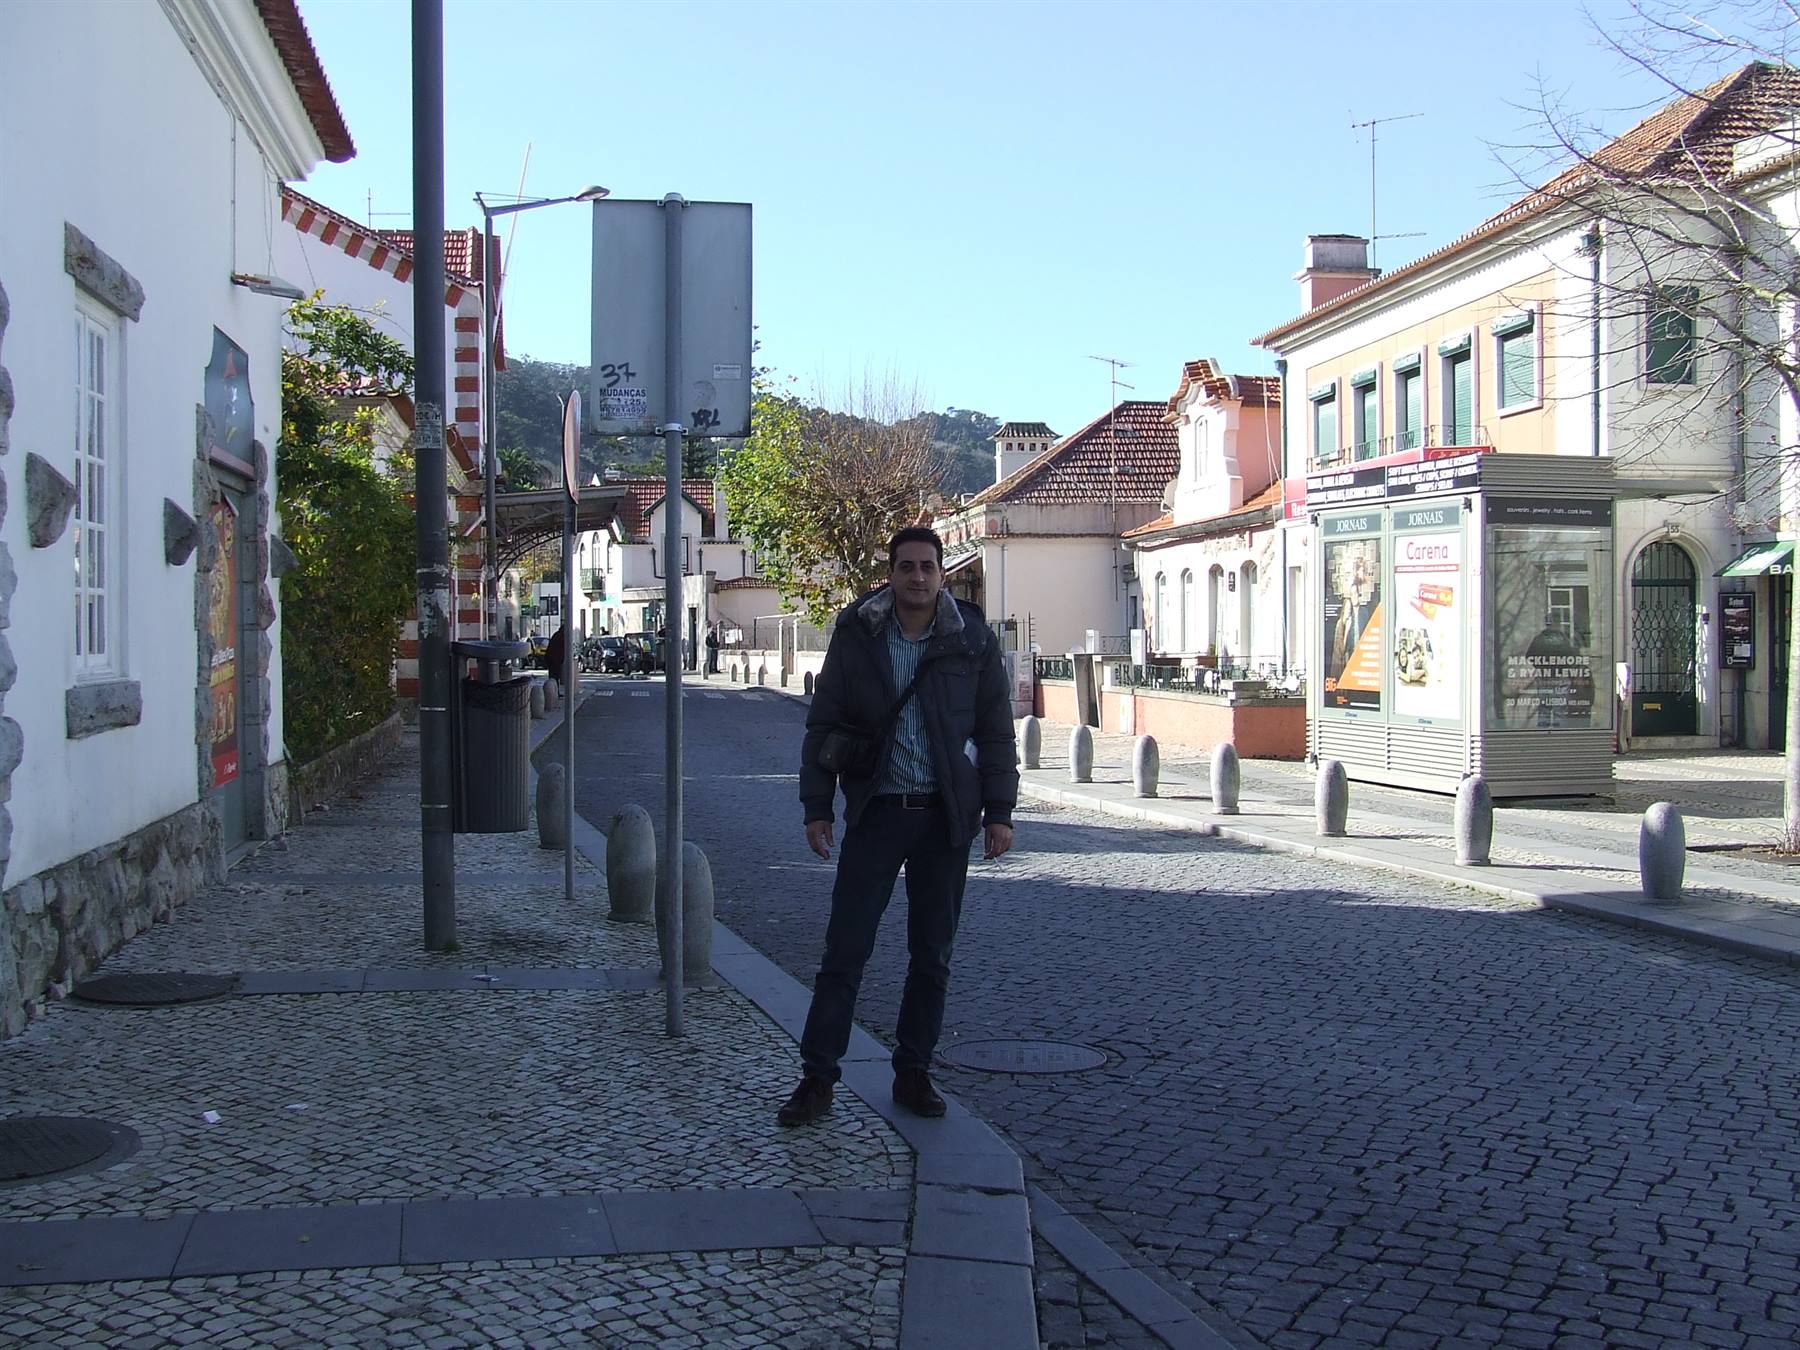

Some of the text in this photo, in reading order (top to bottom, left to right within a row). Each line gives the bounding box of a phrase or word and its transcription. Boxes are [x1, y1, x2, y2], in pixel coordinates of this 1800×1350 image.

[600, 362, 637, 388] 37
[1336, 518, 1367, 532] JORNAIS
[1408, 511, 1443, 526] JORNAIS
[1408, 542, 1448, 560] Carena
[1508, 656, 1590, 666] MACKLEMORE
[1520, 668, 1552, 678] RYAN
[1555, 668, 1590, 678] LEWIS
